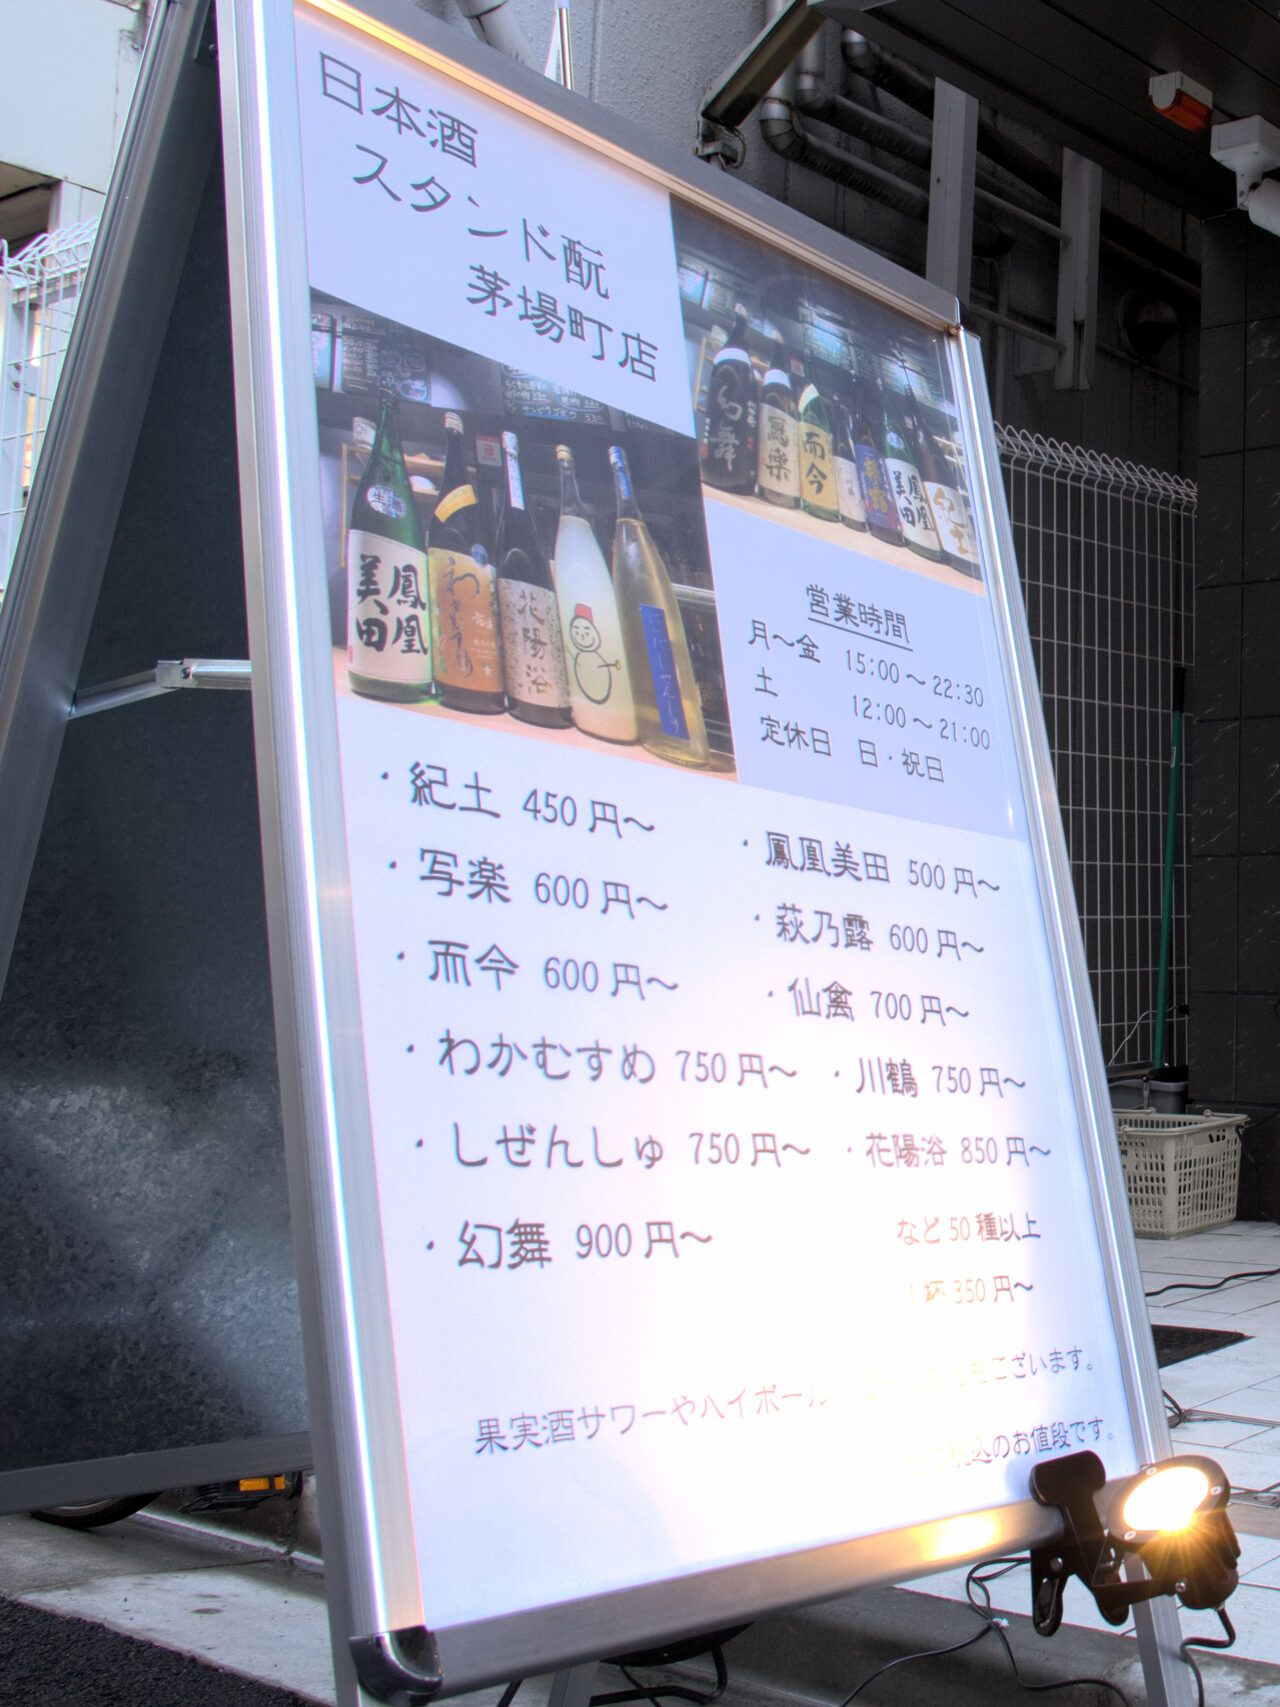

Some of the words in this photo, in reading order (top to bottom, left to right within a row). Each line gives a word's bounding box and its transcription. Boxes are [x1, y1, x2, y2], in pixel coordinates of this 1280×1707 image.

[319, 51, 478, 168] 日本酒
[353, 144, 609, 299] スタンド酛
[467, 264, 659, 381] 茅場町店
[355, 553, 390, 653] 美田
[389, 563, 429, 656] 鳳凰
[806, 583, 910, 644] 営業時間
[754, 666, 778, 697] 土
[760, 714, 832, 757] 定休日
[410, 761, 501, 819] 紀土
[419, 848, 512, 903] 写楽
[766, 831, 891, 883] 鳳凰美田
[776, 902, 874, 951] 萩乃露
[428, 940, 520, 990] 而今
[788, 977, 855, 1021] 仙禽
[438, 1029, 656, 1084] わかむすめ
[856, 1056, 918, 1098] 川鶴
[453, 1121, 664, 1169] しぜんしゅ
[865, 1132, 947, 1168] 花陽浴
[458, 1217, 552, 1269] 幻舞
[897, 1212, 1042, 1245] など50種以上
